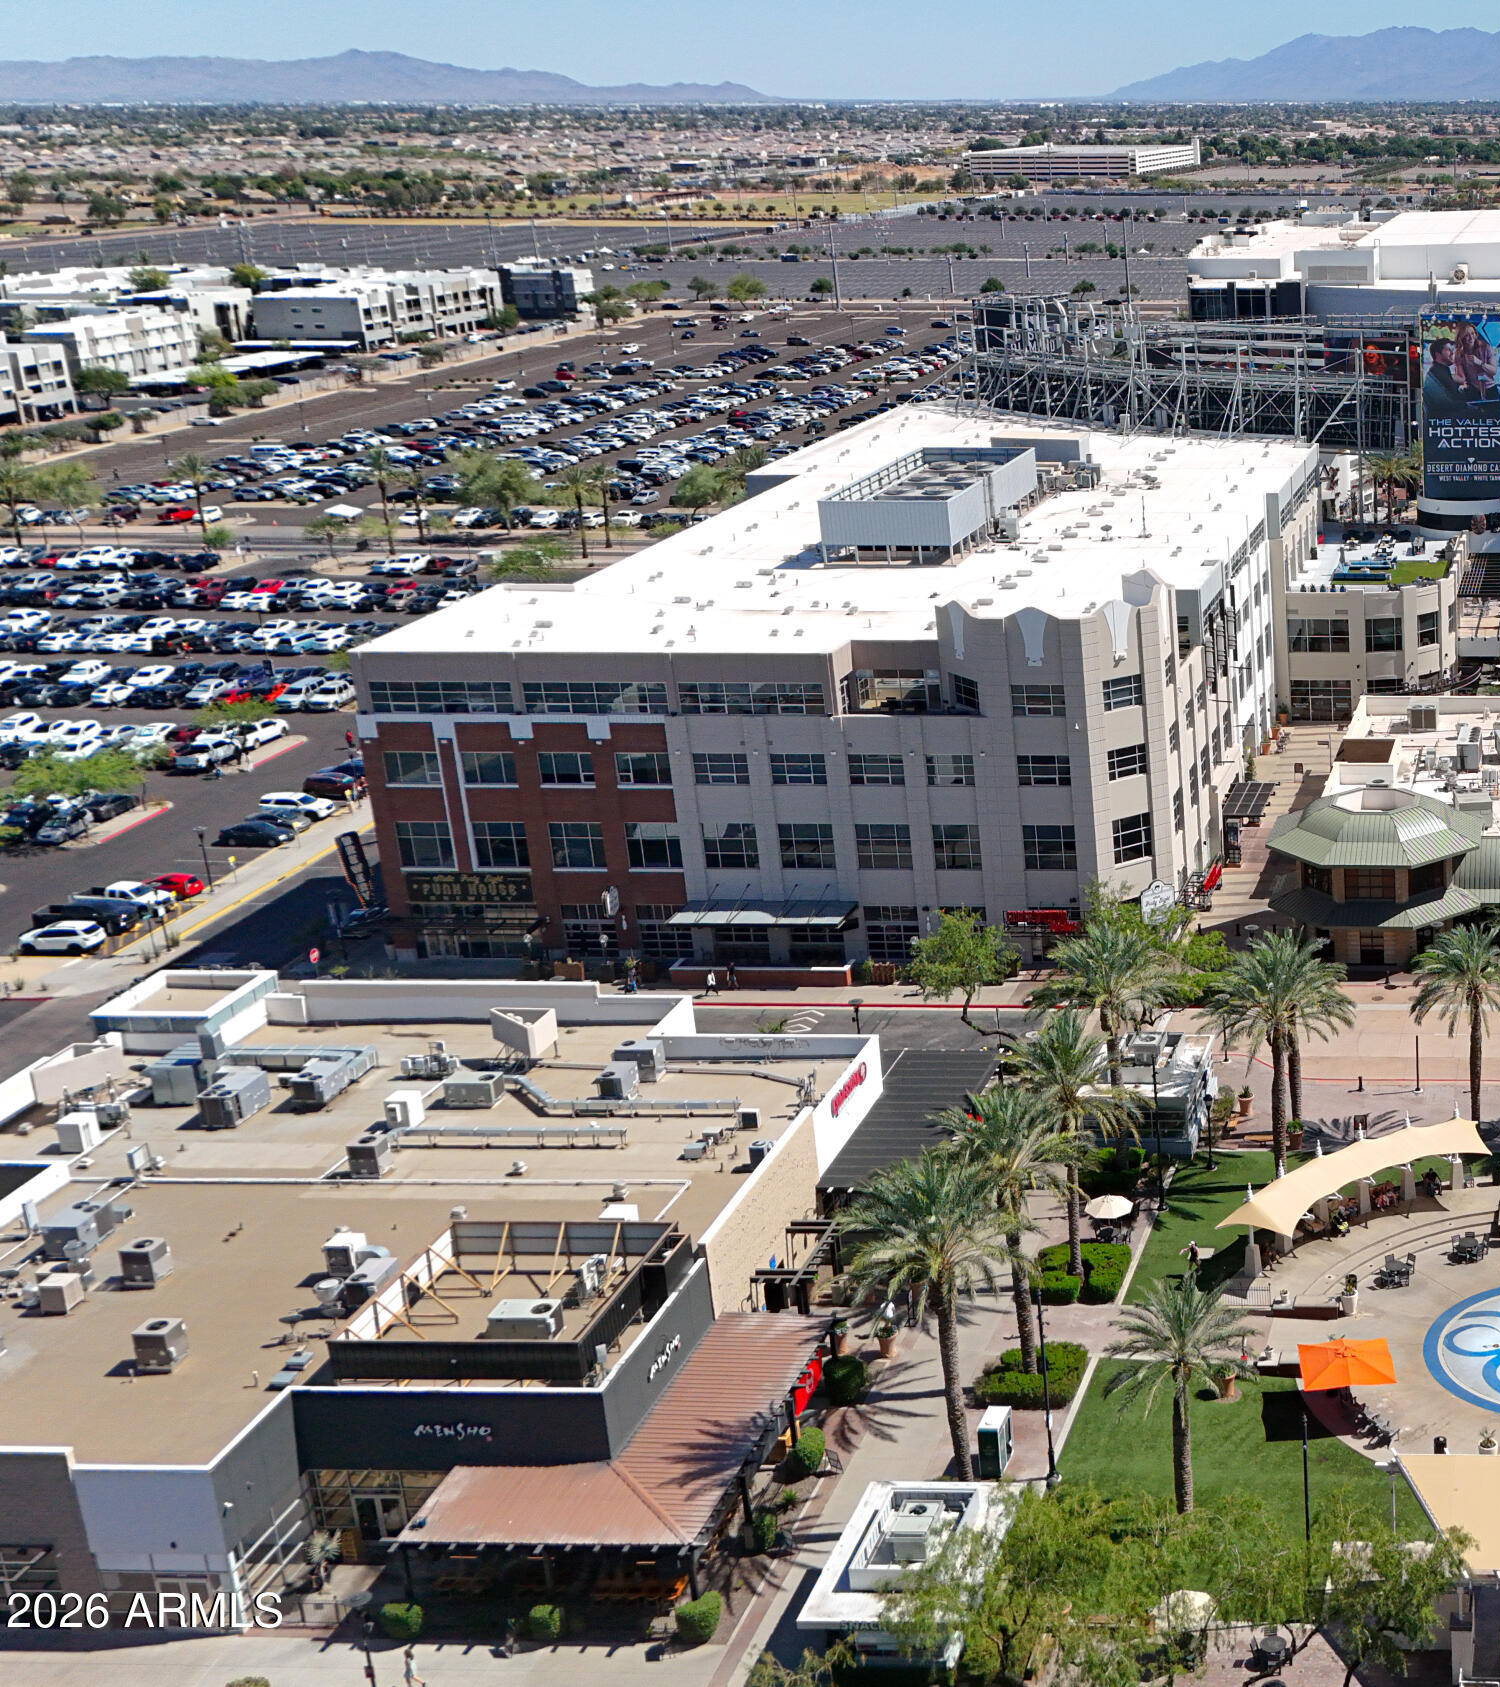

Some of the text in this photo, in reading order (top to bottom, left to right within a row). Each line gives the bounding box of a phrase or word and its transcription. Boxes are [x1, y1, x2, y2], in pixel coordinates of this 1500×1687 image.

[1429, 418, 1452, 426] THE
[1426, 464, 1453, 473] DESERT
[1455, 463, 1488, 472] DIAMOND
[413, 1422, 492, 1440] MENSHO
